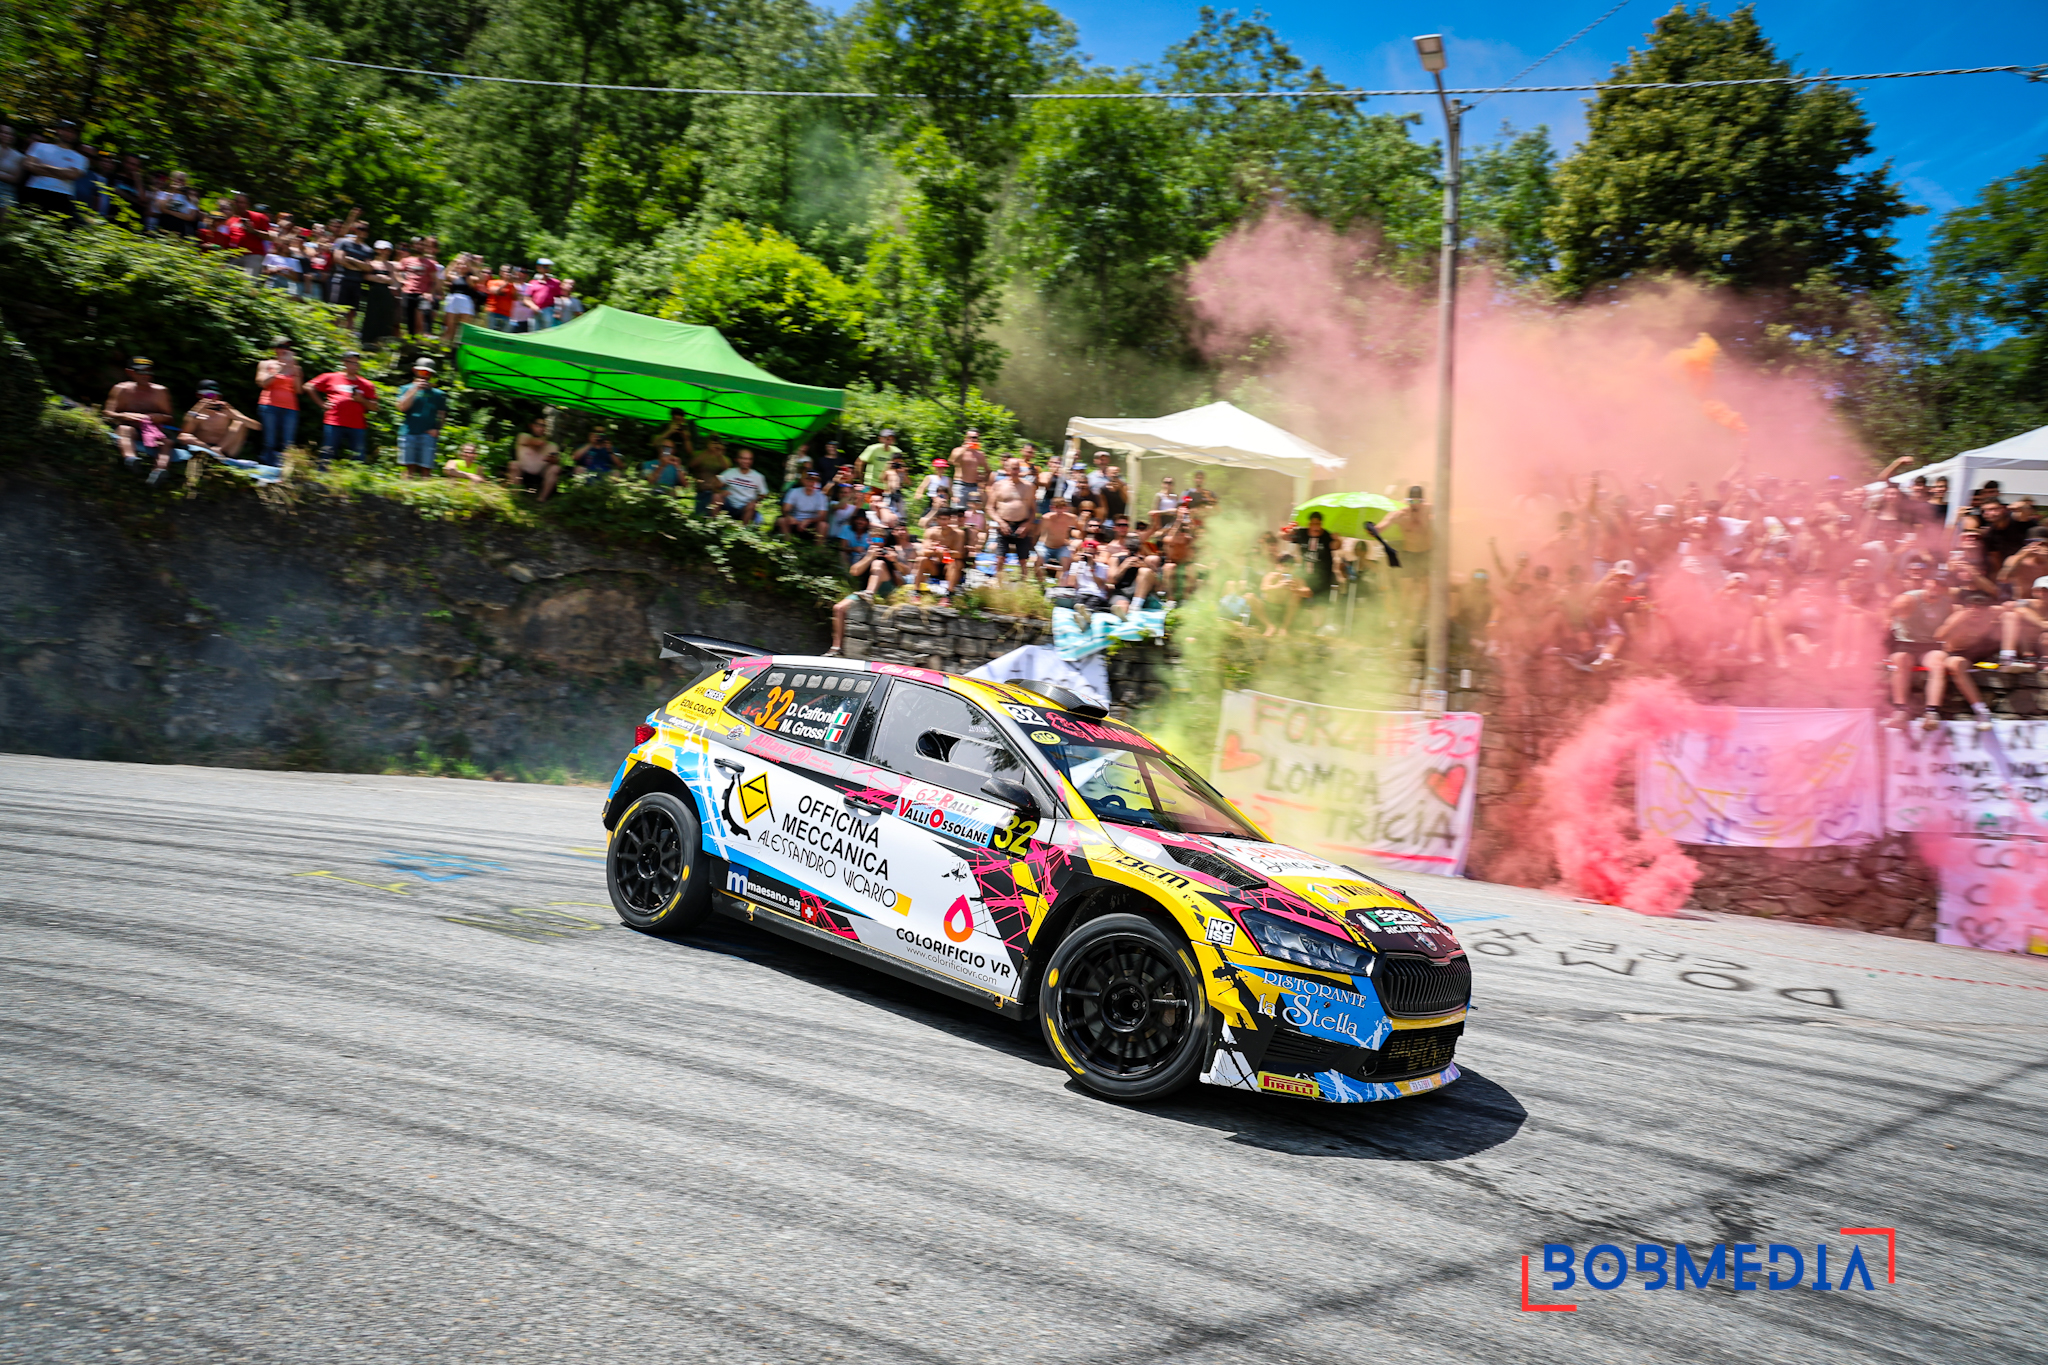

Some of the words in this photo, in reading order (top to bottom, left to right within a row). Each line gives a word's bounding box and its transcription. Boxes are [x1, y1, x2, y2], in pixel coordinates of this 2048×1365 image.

[693, 702, 717, 717] COLOR
[754, 686, 794, 731] 32
[785, 702, 797, 716] D.
[798, 705, 841, 724] Caffoni
[1008, 706, 1043, 723] 32
[750, 734, 793, 756] Allianz
[778, 719, 791, 733] M.
[792, 721, 828, 740] Grossi
[1264, 757, 1385, 806] LOMBA
[798, 795, 879, 848] OFFICINA
[994, 814, 1038, 857] 32
[1323, 804, 1458, 849] TRICIA
[782, 813, 889, 881] MECCANICA
[757, 830, 837, 878] ALESSANDRO
[843, 867, 897, 908] VICARIO
[748, 881, 788, 904] maesano
[789, 898, 801, 911] ag
[1207, 929, 1232, 944] ISE
[1210, 919, 1234, 934] NO
[896, 927, 985, 968] COLORIFICIO
[990, 959, 1011, 978] VR
[906, 946, 997, 985] www.colorificiovr.com
[1262, 971, 1367, 1008] RISTORANTE
[1257, 994, 1277, 1018] la
[1282, 994, 1358, 1036] Stella
[1264, 1075, 1314, 1095] PIRELLI
